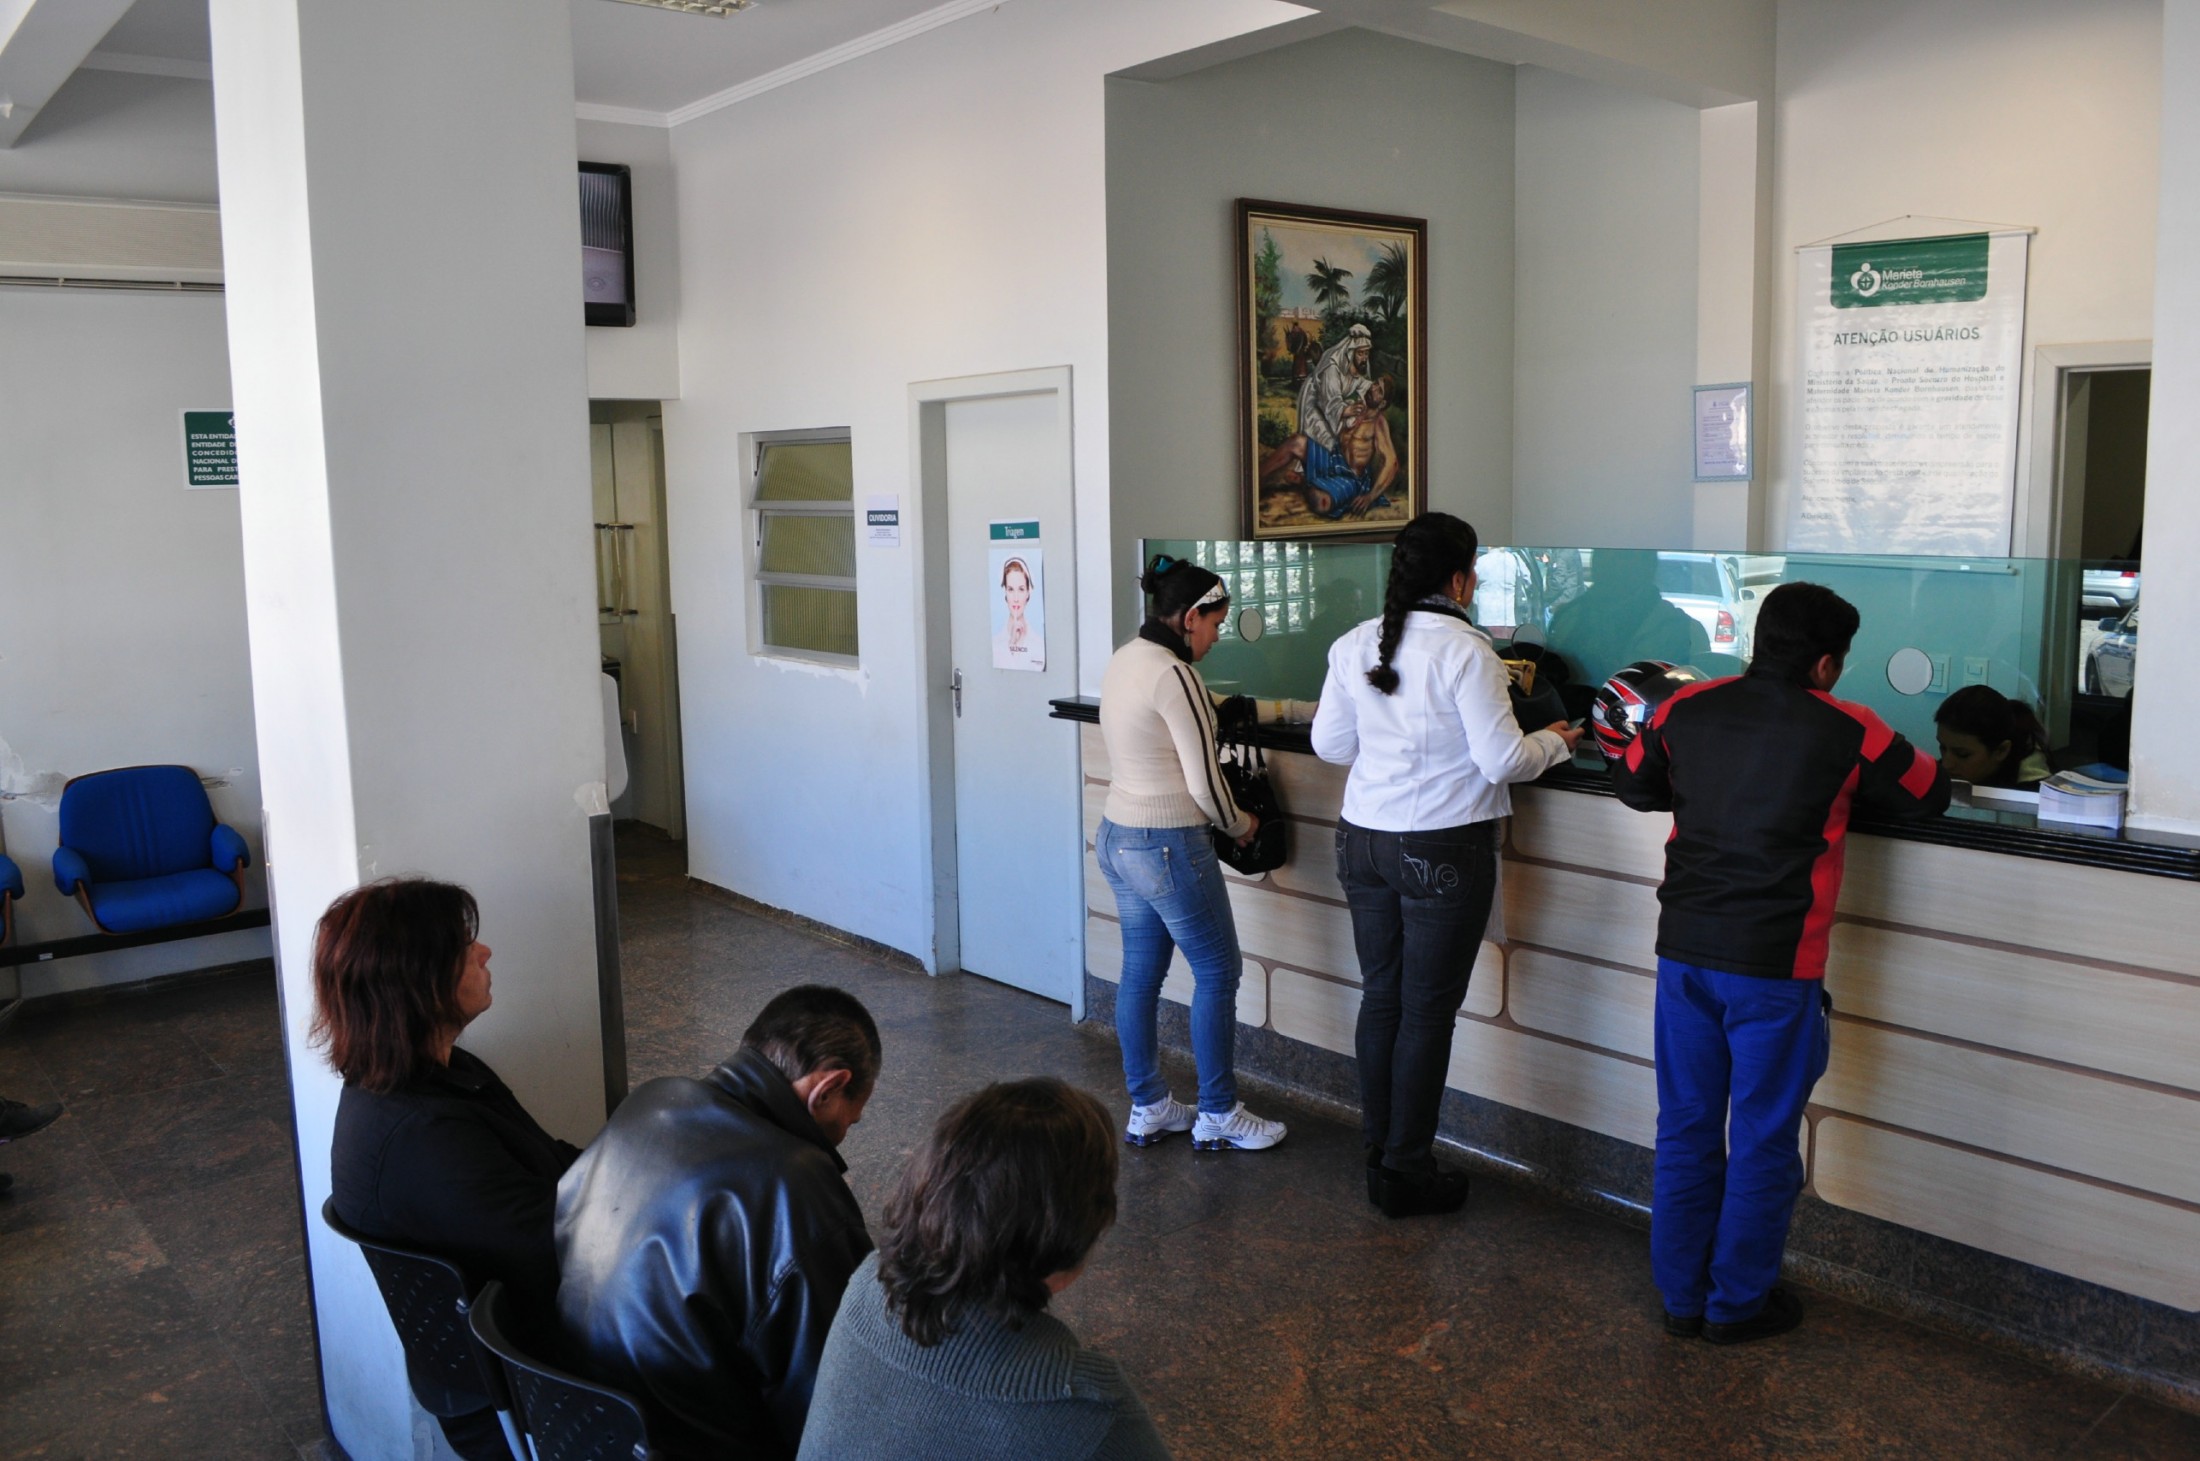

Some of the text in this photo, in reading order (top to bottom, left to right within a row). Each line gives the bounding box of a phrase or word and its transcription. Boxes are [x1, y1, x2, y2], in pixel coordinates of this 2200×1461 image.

[1882, 268, 1923, 281] Marieta
[1881, 277, 1966, 290] Konder Bornhausen
[1834, 325, 1980, 346] ATENÇÃO USUÁRIOS
[1939, 365, 1990, 374] Humanização
[1995, 364, 2005, 372] do
[1964, 374, 1997, 384] Hospital
[1004, 525, 1025, 539] Triagem
